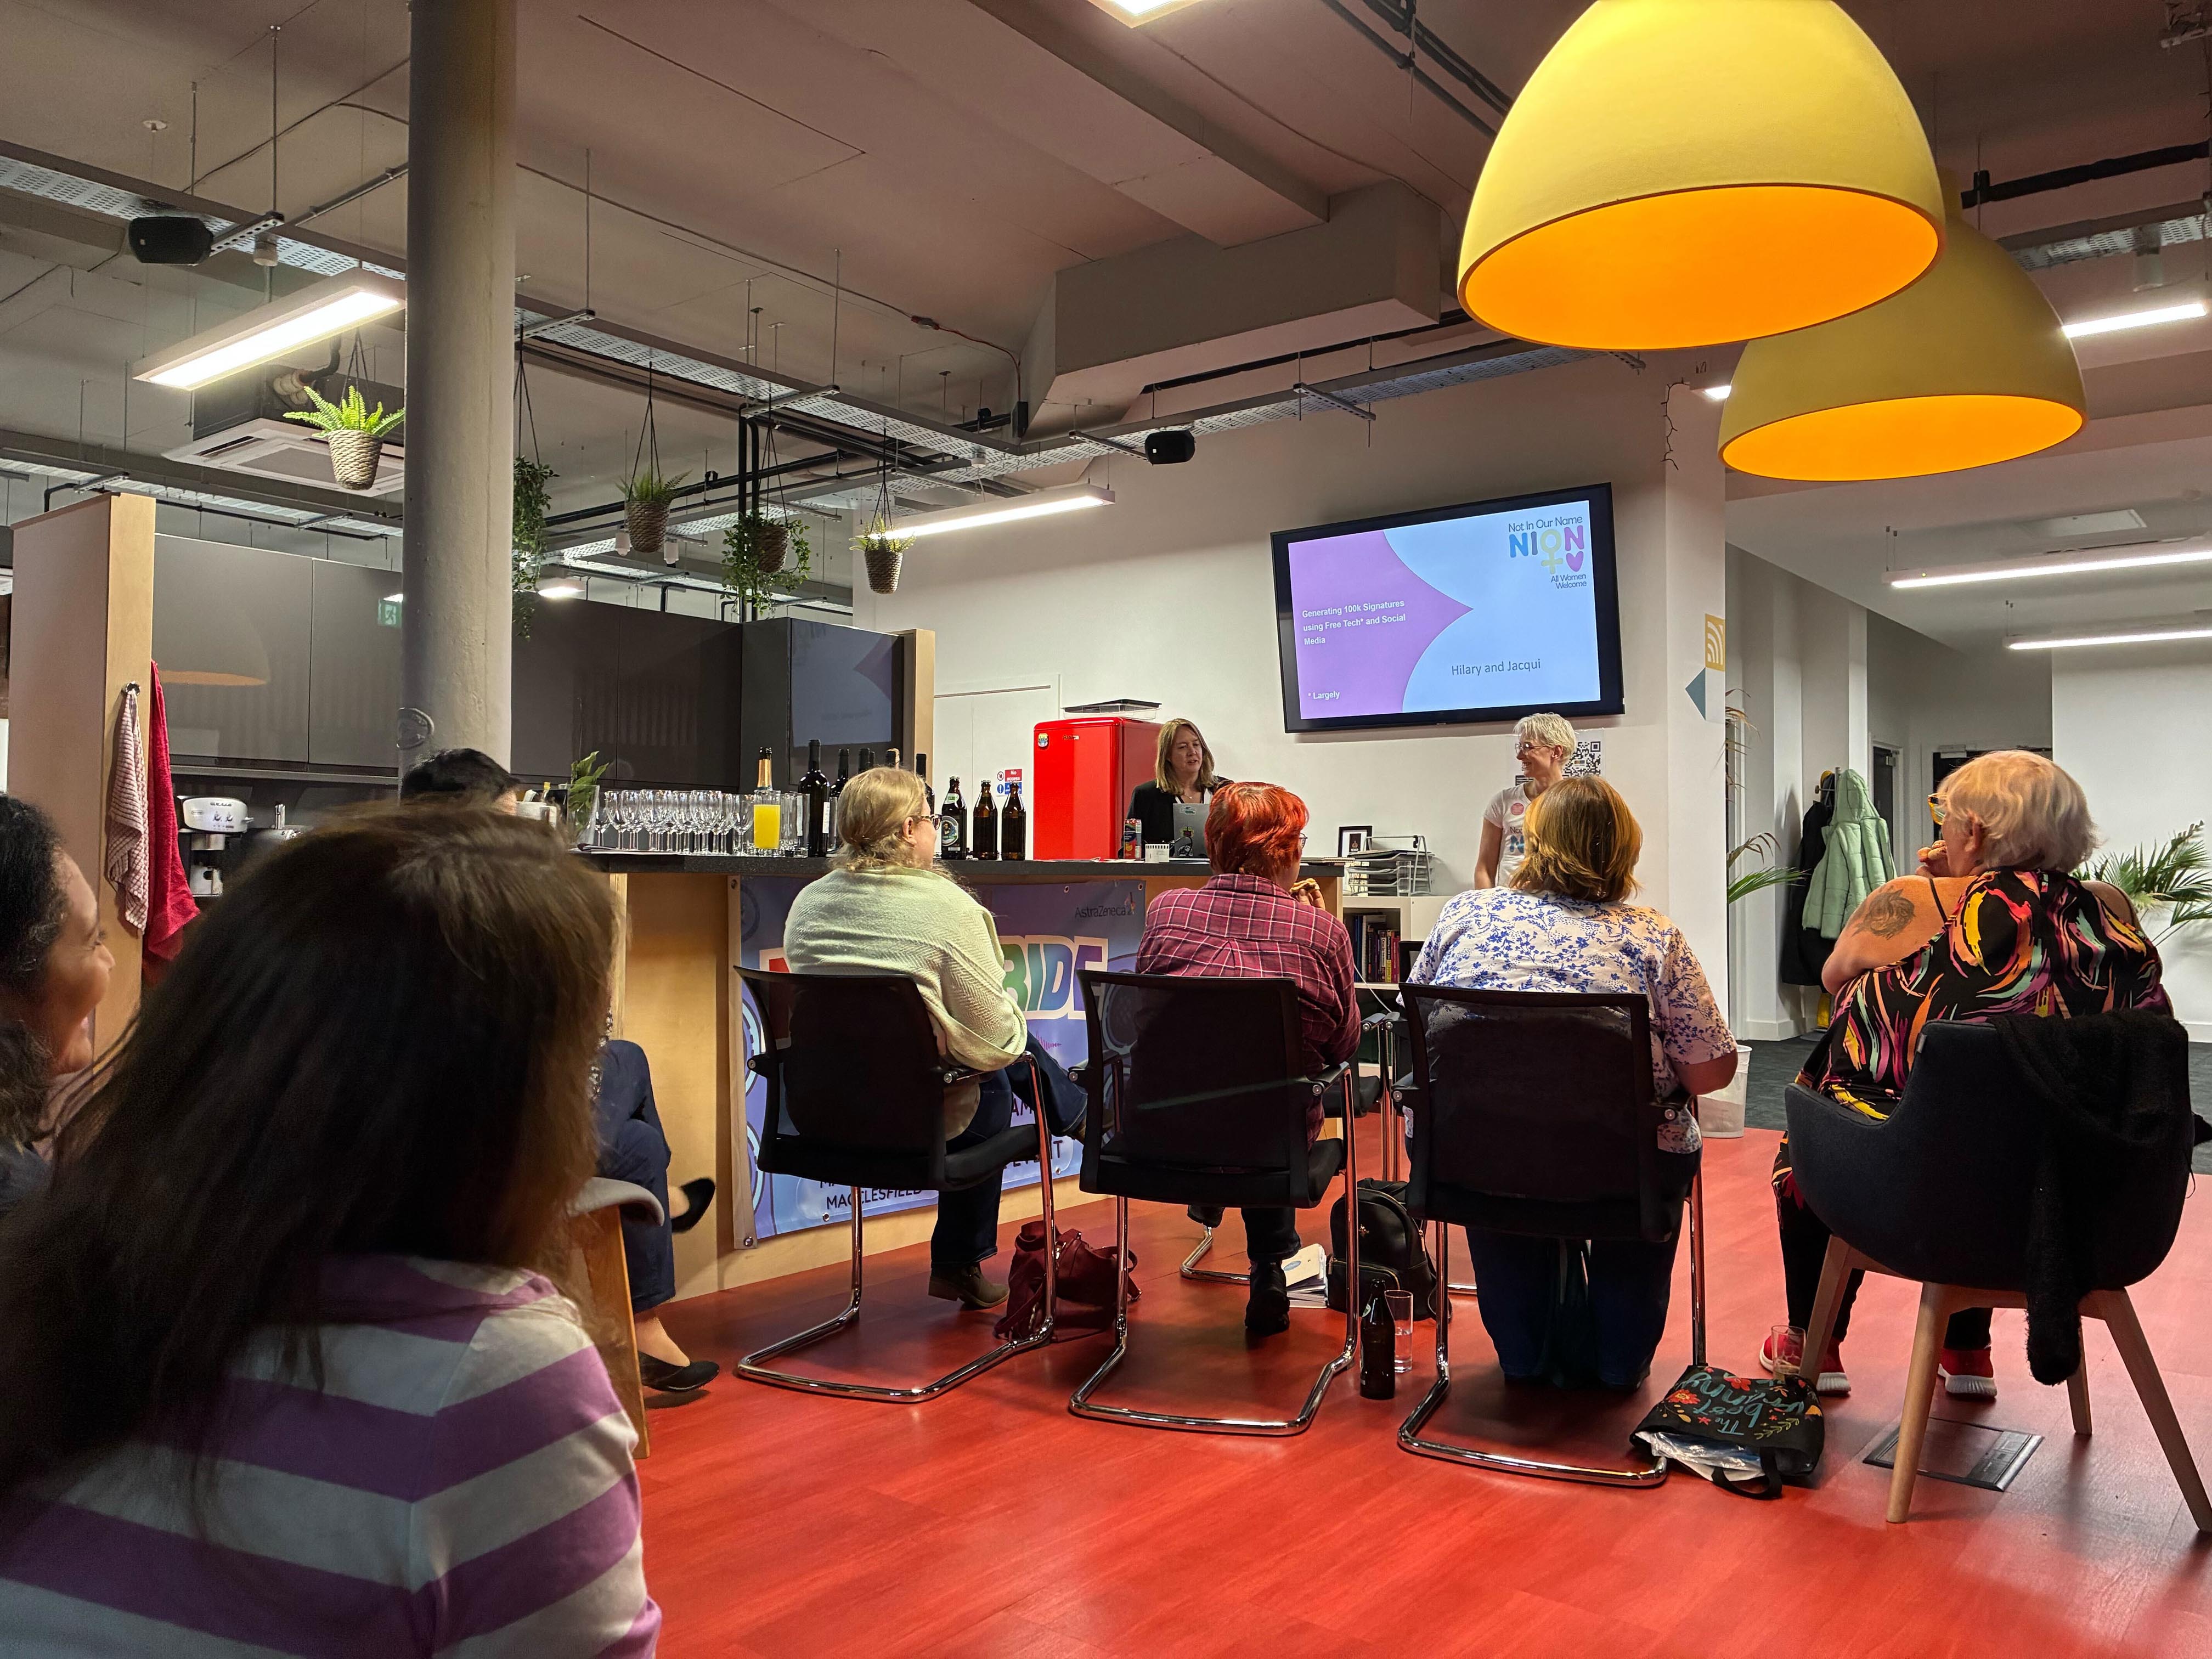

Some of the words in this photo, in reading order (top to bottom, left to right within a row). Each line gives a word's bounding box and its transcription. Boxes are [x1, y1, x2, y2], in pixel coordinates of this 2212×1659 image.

[1509, 523, 1524, 532] Not
[1526, 521, 1534, 530] In
[1536, 520, 1553, 528] Our
[1555, 516, 1583, 526] Name
[1555, 581, 1587, 589] Welcome
[1302, 607, 1342, 618] Generating
[1344, 605, 1362, 613] 100k
[1363, 601, 1405, 612] Signatures
[1365, 617, 1380, 625] and
[1381, 613, 1406, 623] Social
[1304, 636, 1325, 645] Media
[1452, 664, 1481, 676] Hilary
[1485, 661, 1504, 673] and
[1507, 658, 1541, 672] Jacqui
[1313, 691, 1340, 700] Largely
[1075, 906, 1126, 918] AstraZeneca
[1001, 939, 1105, 1015] RIDE
[827, 1189, 922, 1210] MACLESFIEL
